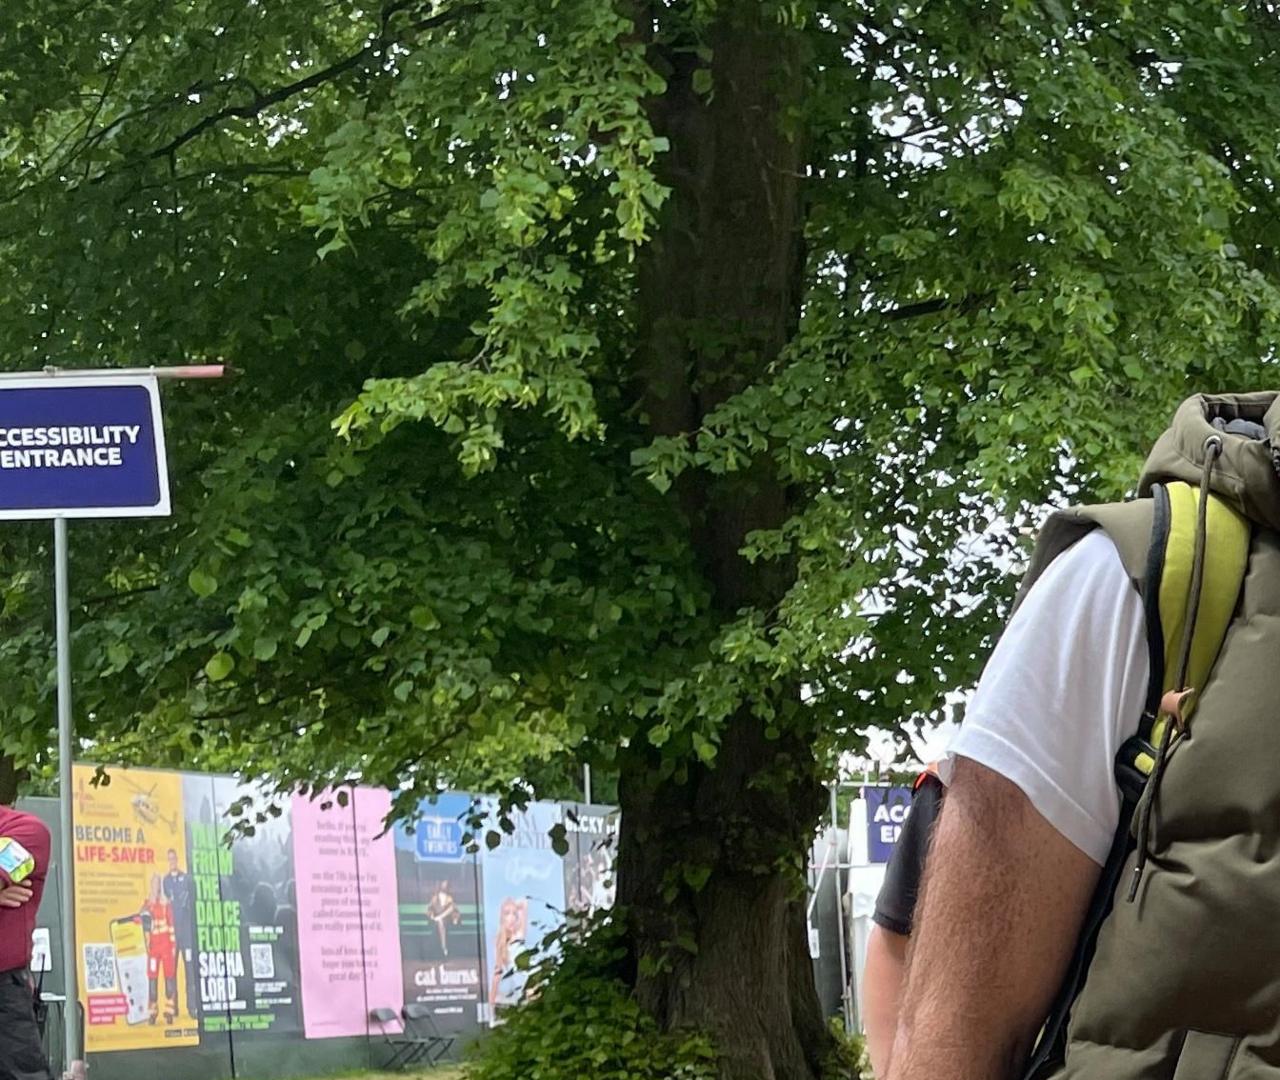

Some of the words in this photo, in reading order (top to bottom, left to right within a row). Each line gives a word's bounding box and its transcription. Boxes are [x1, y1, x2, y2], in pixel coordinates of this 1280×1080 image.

[1, 447, 123, 468] ENTRANCE
[75, 825, 132, 843] BECOME
[135, 827, 146, 844] A
[76, 845, 155, 864] LIFE-SAVER
[192, 849, 234, 875] FROM
[194, 875, 220, 900] THE
[196, 900, 240, 927] DANCE
[197, 926, 241, 952] FLOOR
[199, 951, 244, 977] SACHA
[415, 967, 437, 986] cat
[439, 964, 478, 985] burns
[200, 976, 237, 1002] LORD
